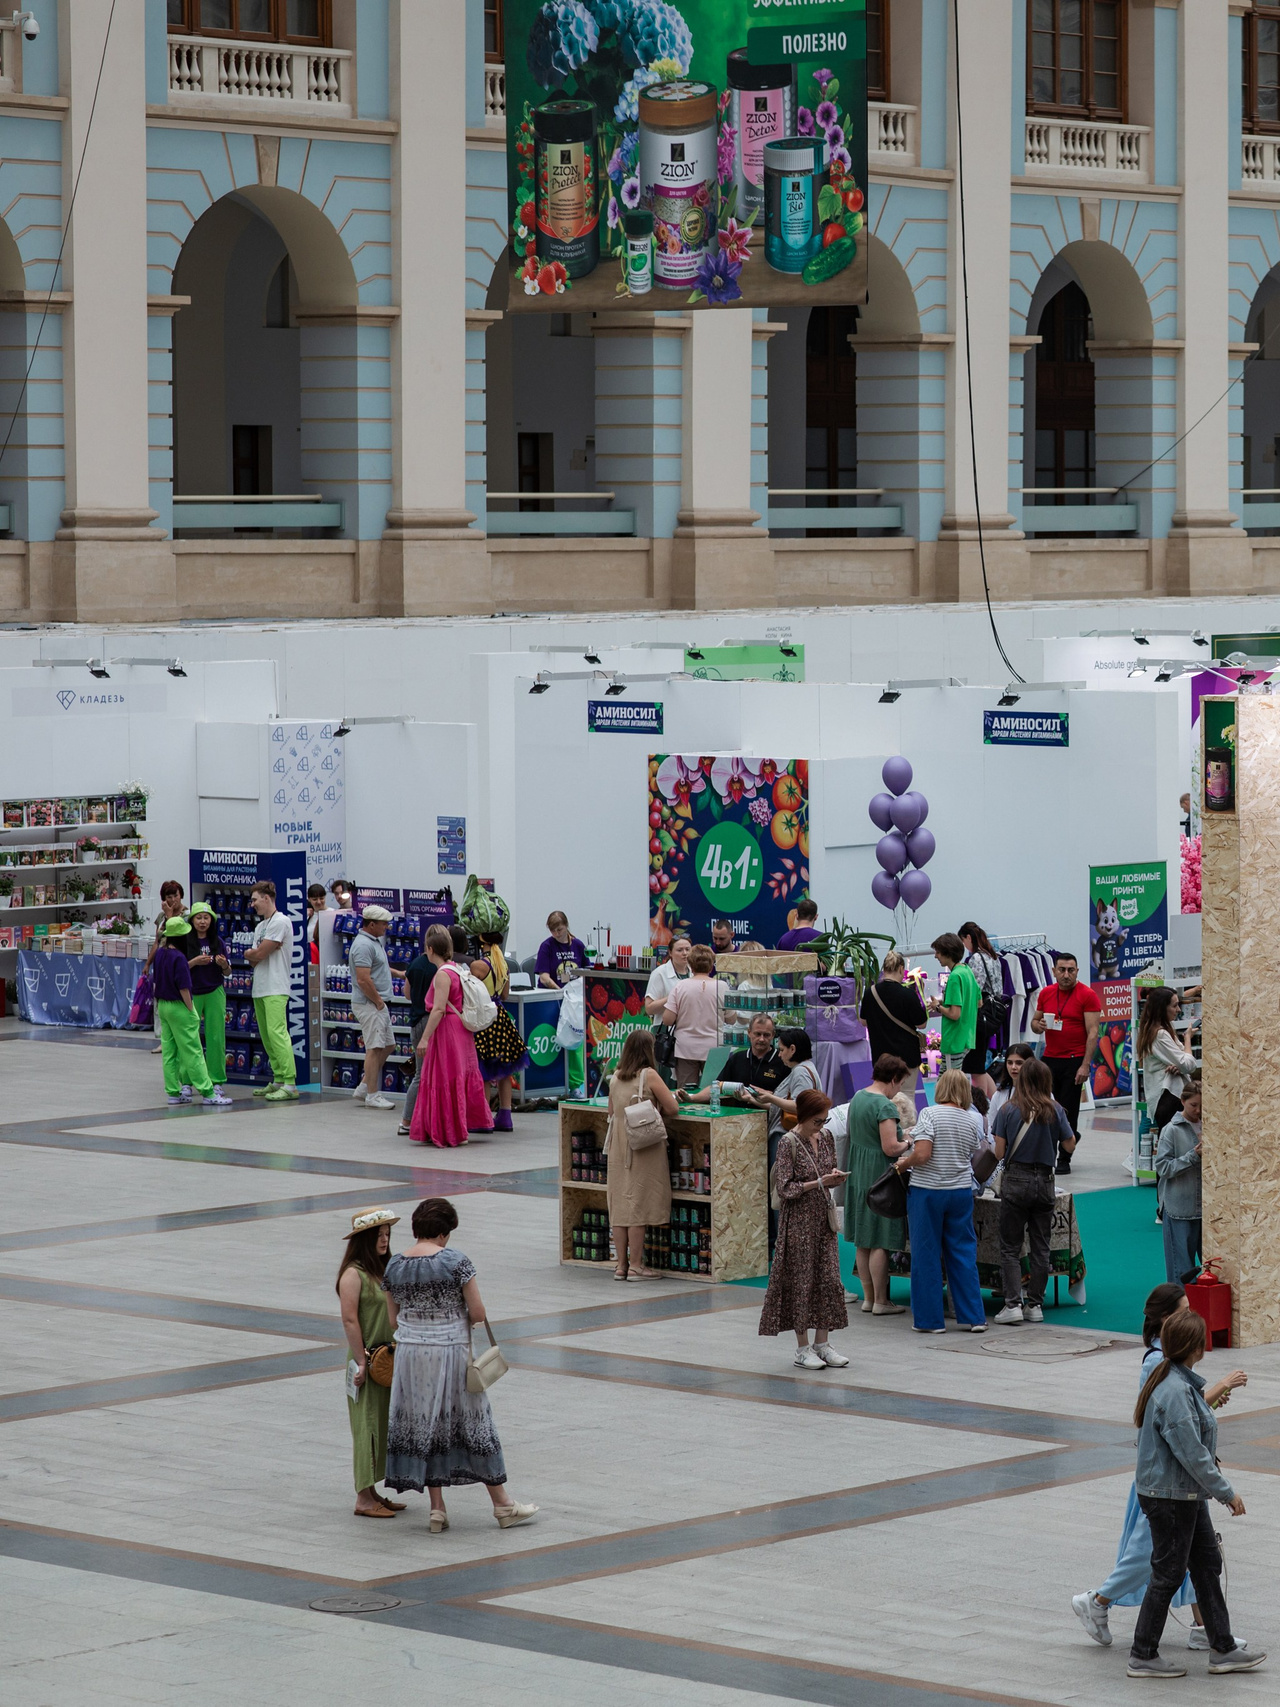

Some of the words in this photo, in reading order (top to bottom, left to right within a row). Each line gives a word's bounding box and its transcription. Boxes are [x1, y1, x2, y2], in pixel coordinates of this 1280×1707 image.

[782, 31, 847, 54] ПОЛЕЗНО
[746, 112, 777, 124] ZION
[745, 124, 779, 138] Detox
[552, 165, 579, 176] ZION
[660, 162, 696, 177] ZION
[551, 172, 581, 189] Protect
[786, 192, 806, 201] ZION
[788, 201, 804, 213] Bio
[1094, 660, 1125, 670] Absolute
[80, 694, 125, 704] КЛАДЕЗЬ
[595, 706, 656, 719] АМИНОСИЛ
[992, 717, 1061, 731] АМИНОСИЛ
[274, 820, 313, 833] НОВЫЕ
[287, 832, 321, 844] ГРАНИ
[310, 842, 342, 853] ВАШИХ
[203, 851, 258, 865] АМИНОСИЛ
[306, 852, 343, 865] ЕЧЕНИЙ
[204, 873, 220, 883] 100%
[220, 874, 257, 884] ОРГАНИКА
[1095, 875, 1119, 885] ВАШИ
[1121, 872, 1161, 883] ЛЮБИМЫЕ
[357, 888, 394, 898] АМИНОСИЛ
[1112, 886, 1145, 896] ПРИНТЫ
[421, 905, 447, 913] ОРГАНИКА
[1133, 933, 1163, 943] ТЕПЕРЬ
[1124, 948, 1130, 956] В
[1132, 945, 1163, 957] ЦВЕТАХ
[286, 877, 306, 1059] АМИНОСИЛ
